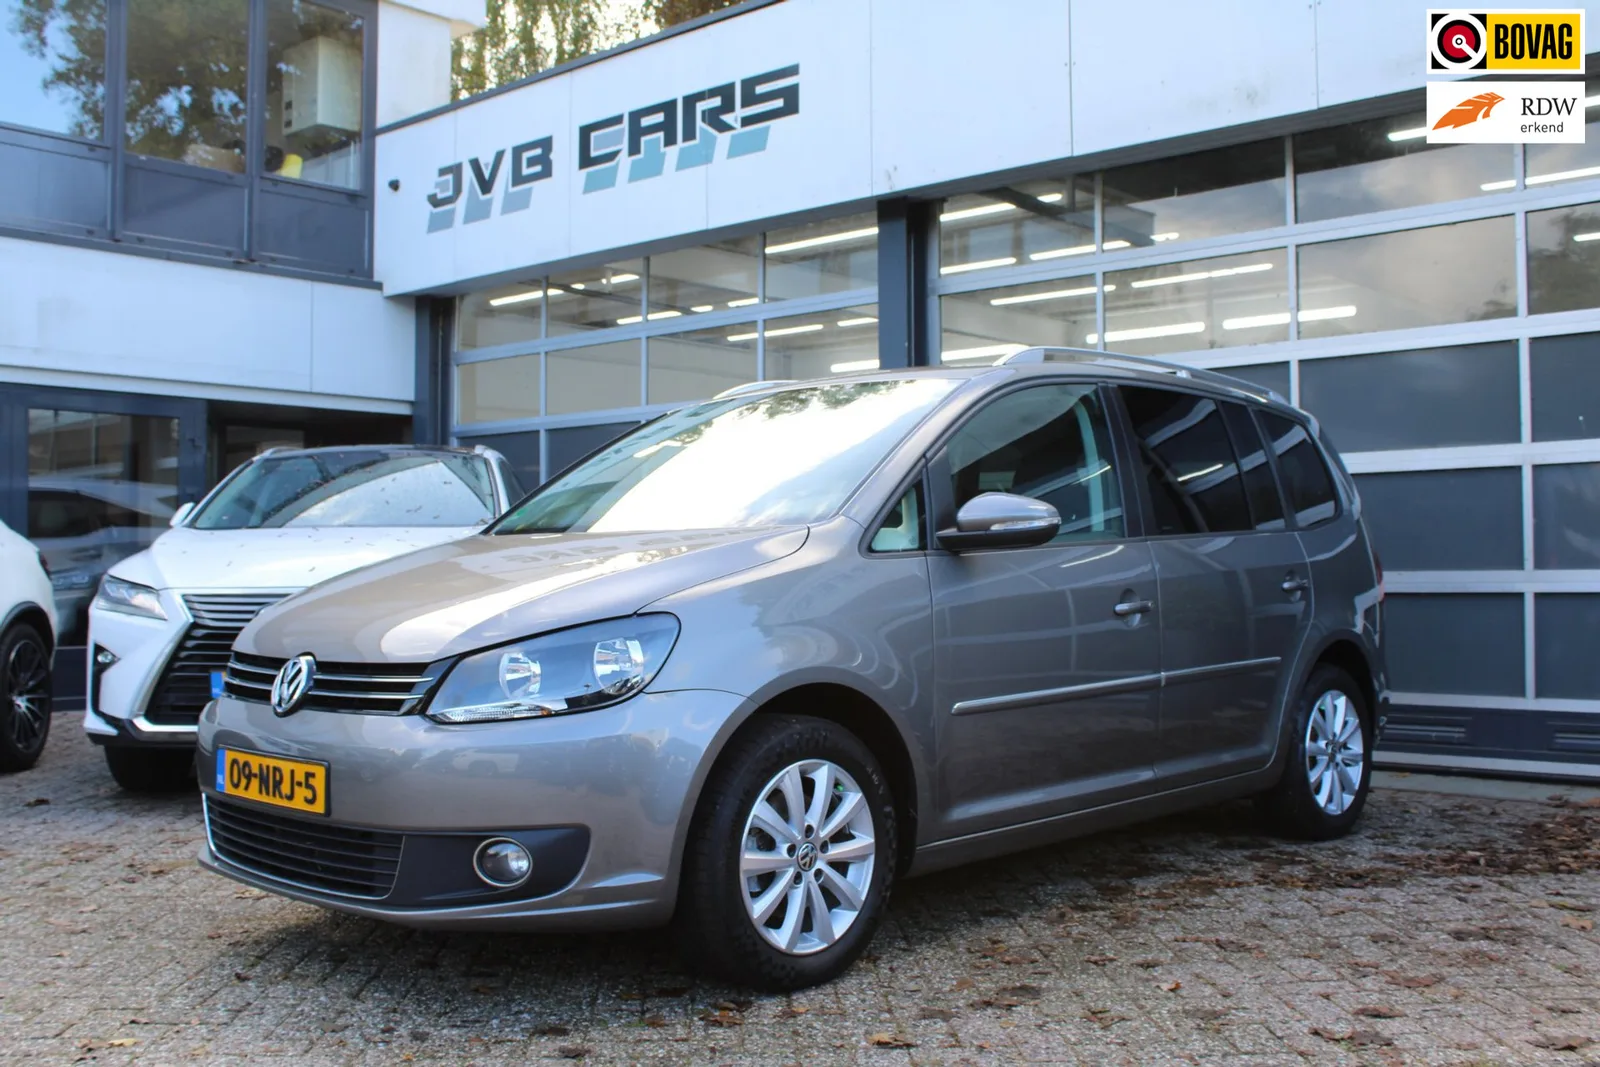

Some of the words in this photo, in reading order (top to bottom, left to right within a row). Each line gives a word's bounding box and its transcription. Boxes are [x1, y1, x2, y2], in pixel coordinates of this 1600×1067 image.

[426, 134, 553, 209] JVB
[578, 62, 800, 171] CARS
[229, 757, 318, 806] 09-NRJ-5
